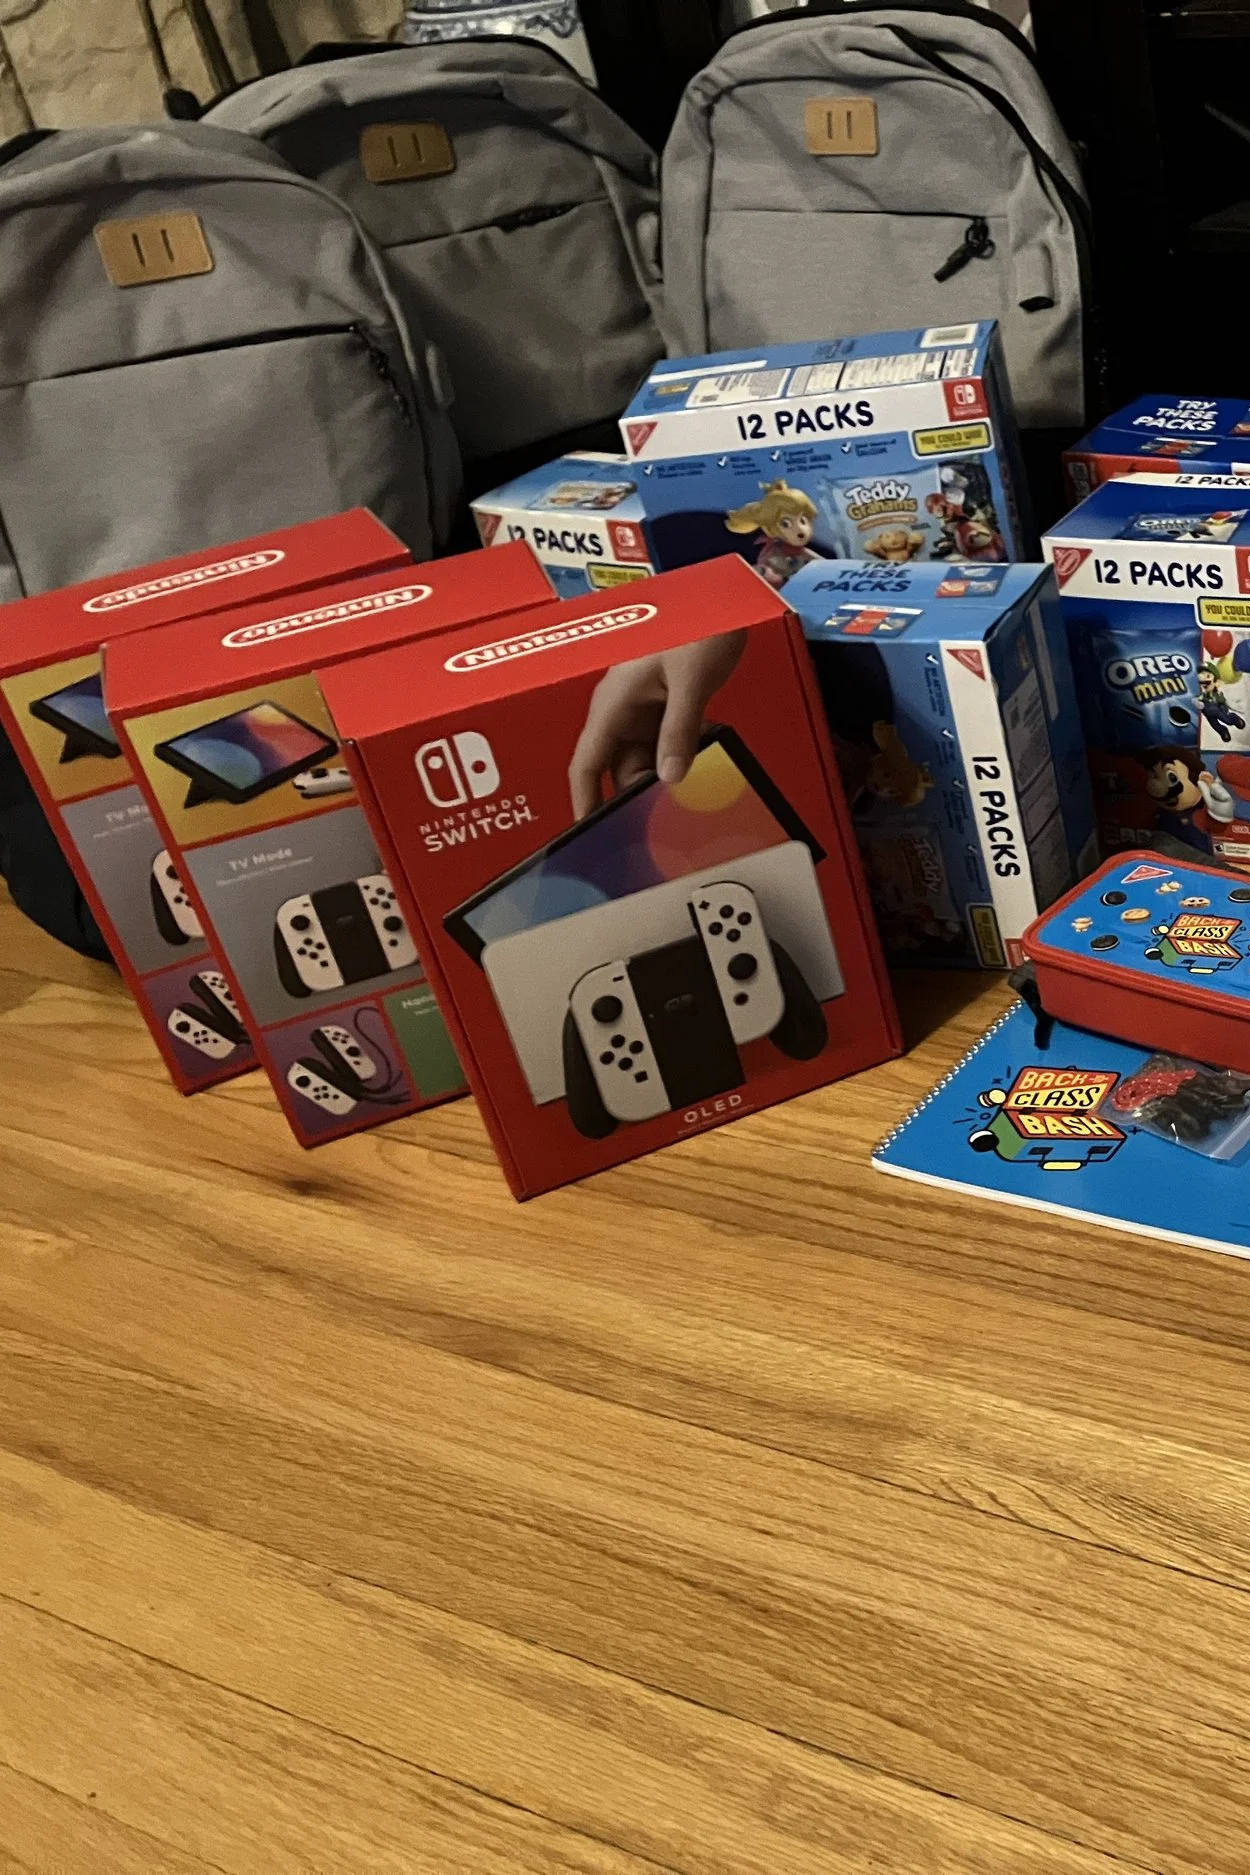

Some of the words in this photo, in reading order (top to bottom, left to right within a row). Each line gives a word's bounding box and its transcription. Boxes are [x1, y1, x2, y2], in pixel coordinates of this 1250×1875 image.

[1156, 408, 1218, 420] THESE
[1177, 400, 1217, 410] TRY
[737, 415, 767, 441] 12
[774, 400, 874, 436] PACKS
[1132, 417, 1217, 431] PACKS
[1175, 476, 1194, 484] 12
[846, 481, 911, 507] Teddy
[847, 499, 918, 521] Grahams
[533, 527, 604, 557] PACKS
[812, 580, 912, 593] PACKS
[837, 569, 912, 580] THESE
[1095, 559, 1121, 584] 12
[1129, 561, 1224, 590] PACKS
[239, 588, 416, 643] Nintendo
[1204, 604, 1223, 615] YOU
[462, 607, 642, 668] Nintendo
[1107, 654, 1191, 686] OREO
[1133, 674, 1186, 702] mini
[972, 756, 1001, 781] 12
[420, 794, 527, 835] NINTENDO
[424, 805, 533, 853] SWITCH
[979, 790, 1021, 878] PACKS
[229, 859, 249, 872] TV
[252, 847, 294, 866] Mode
[1173, 926, 1229, 939] CLASS
[1175, 940, 1235, 957] BASH
[684, 1094, 742, 1123] OLED
[1014, 1086, 1100, 1107] CLASS
[1018, 1114, 1114, 1136] BASH
